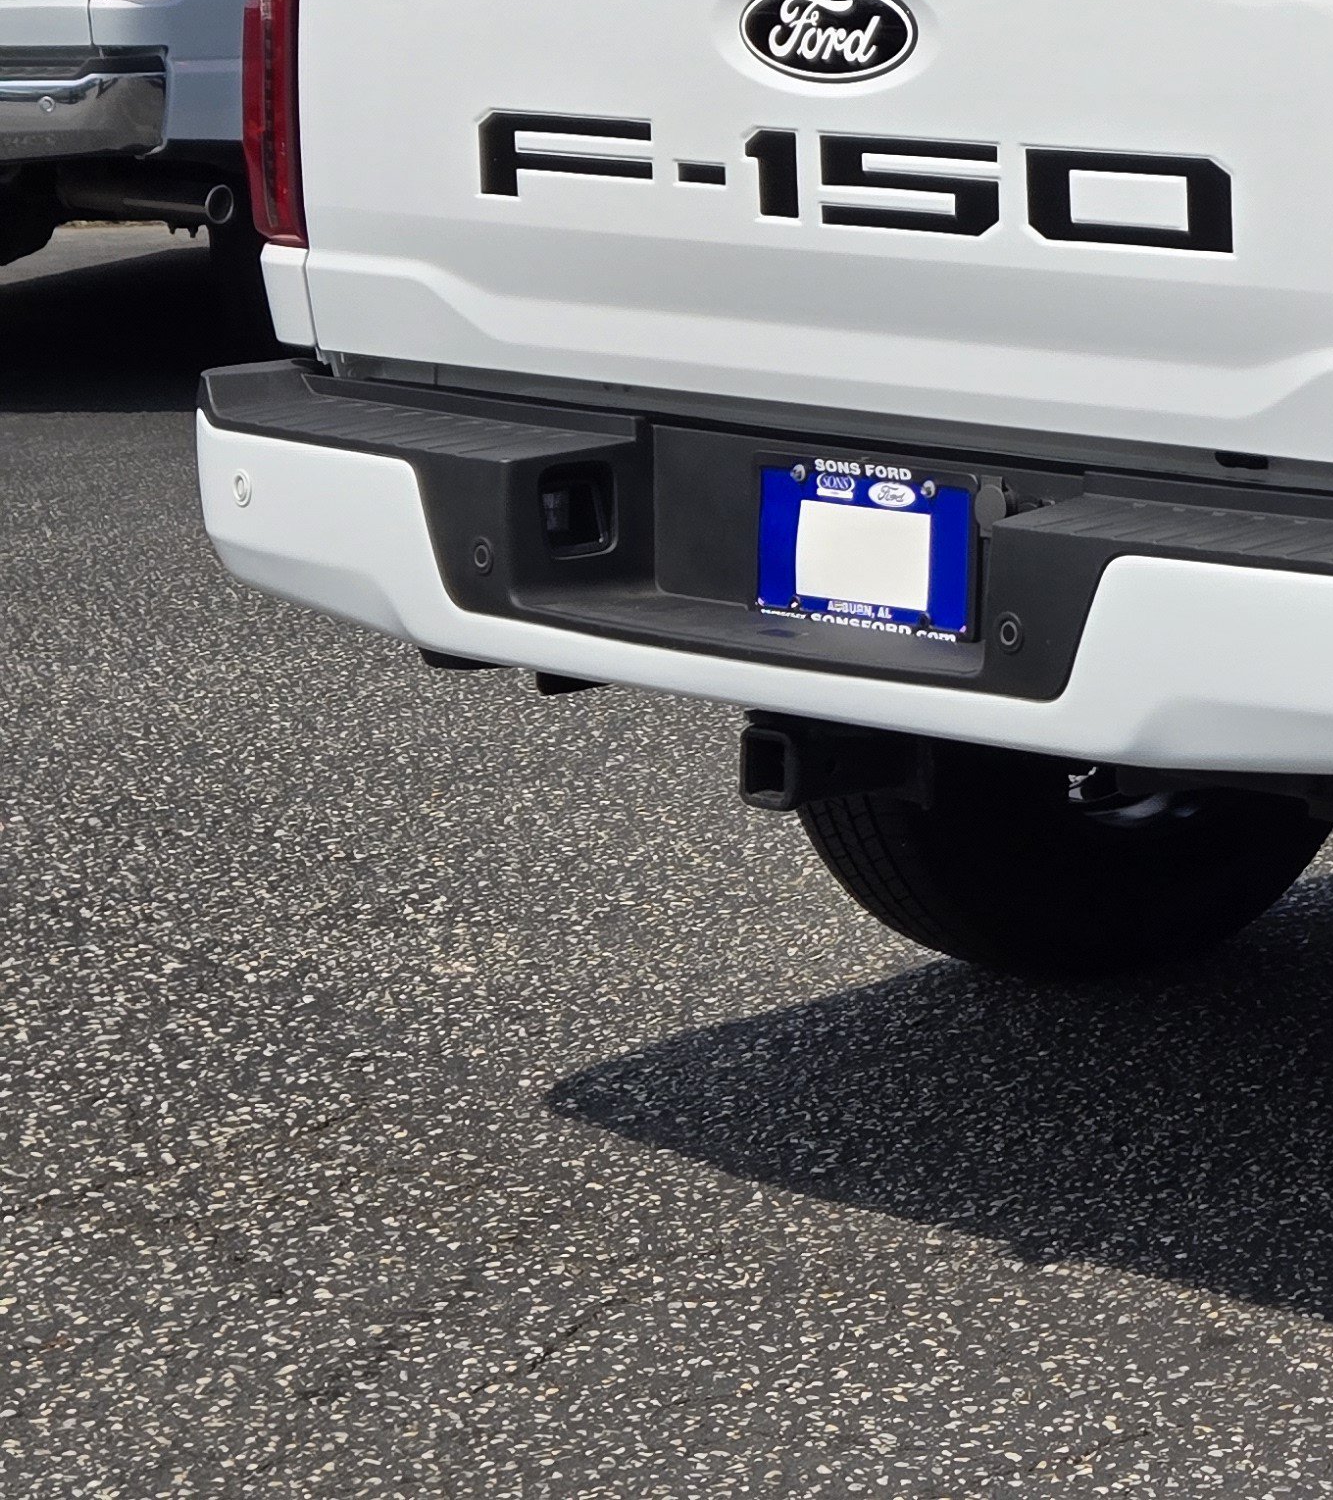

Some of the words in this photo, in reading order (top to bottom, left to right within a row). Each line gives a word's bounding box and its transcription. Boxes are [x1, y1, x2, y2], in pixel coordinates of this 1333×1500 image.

[477, 110, 1235, 256] F-150
[814, 458, 861, 476] SONS
[864, 464, 912, 481] FORD
